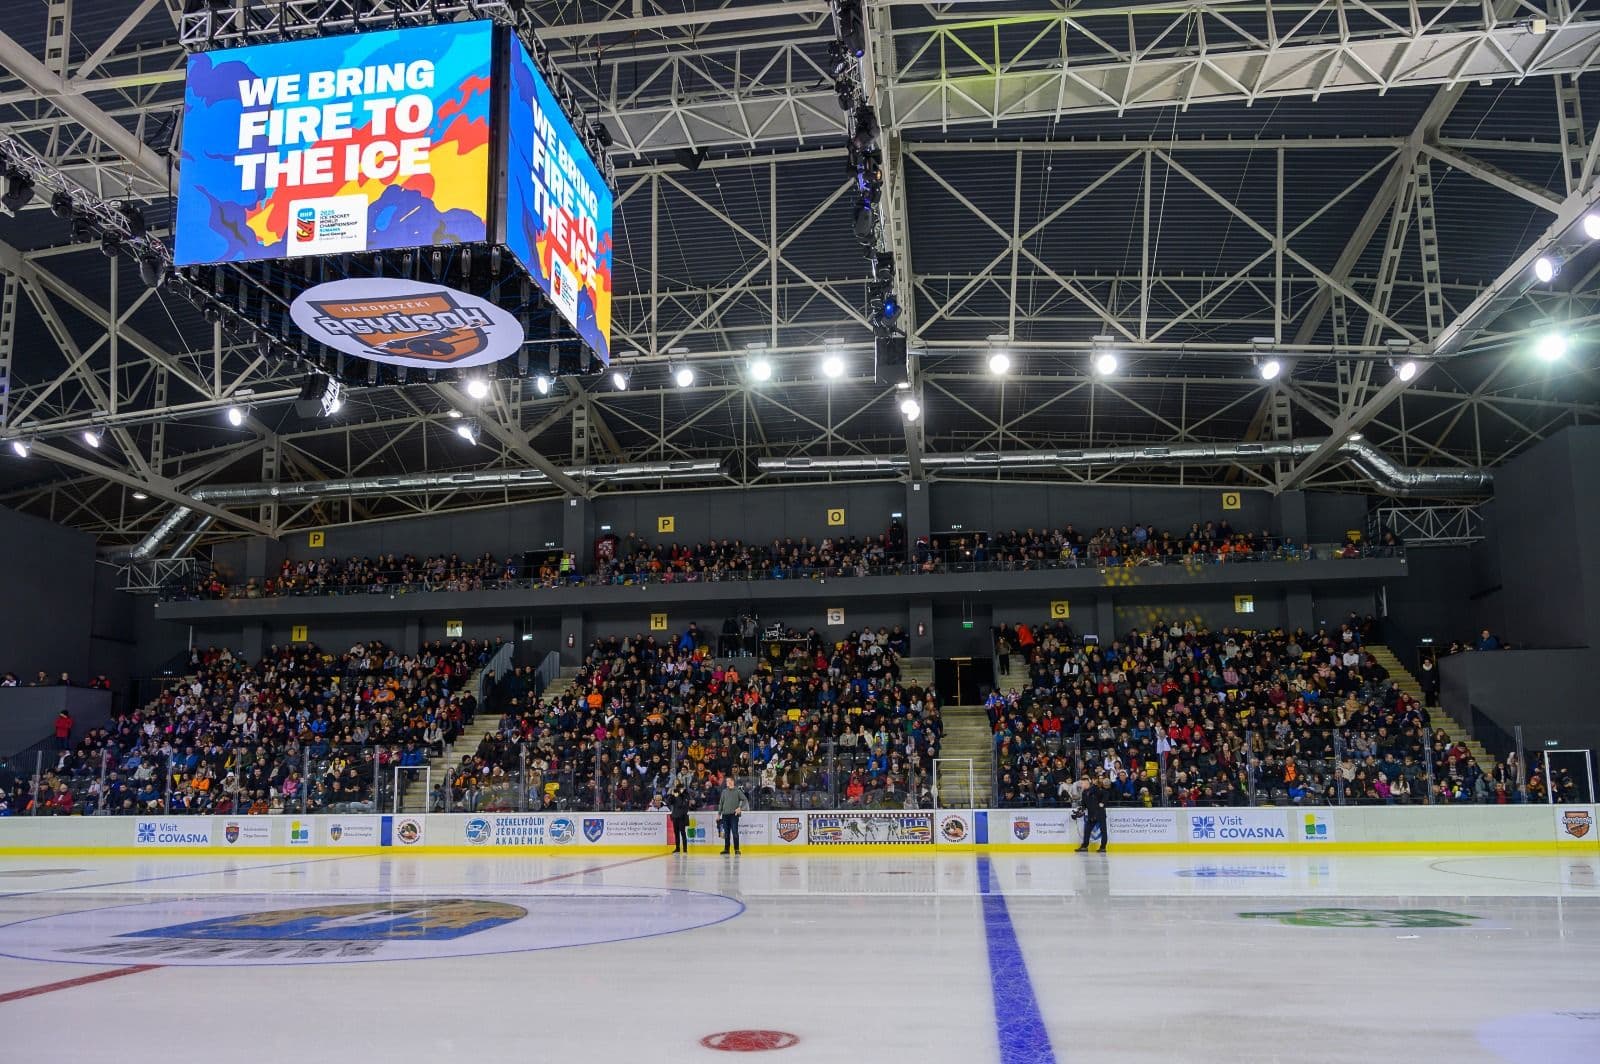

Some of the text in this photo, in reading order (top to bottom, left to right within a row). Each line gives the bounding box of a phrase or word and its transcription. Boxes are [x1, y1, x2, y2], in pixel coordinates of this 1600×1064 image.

[238, 59, 435, 107] WE BRING
[238, 94, 434, 150] FIRE TO
[533, 96, 598, 219] WE BRING
[234, 137, 431, 191] THE ICE
[533, 131, 598, 253] FIRE TO
[531, 171, 568, 252] THE
[570, 230, 597, 289] ICE
[341, 300, 430, 314] HÁROMSZÉKI
[1226, 495, 1237, 506] O
[831, 511, 842, 522] O
[662, 519, 670, 530] P
[313, 534, 320, 545] P
[1054, 603, 1066, 615] G
[655, 616, 664, 628] H
[830, 611, 841, 622] G
[1219, 815, 1243, 826] Visit
[160, 823, 178, 832] Visit
[496, 826, 544, 836] JÉGKORONG
[1219, 827, 1285, 839] COVASNA
[158, 833, 208, 843] COVASNA
[496, 836, 544, 845] AKADÉMIA
